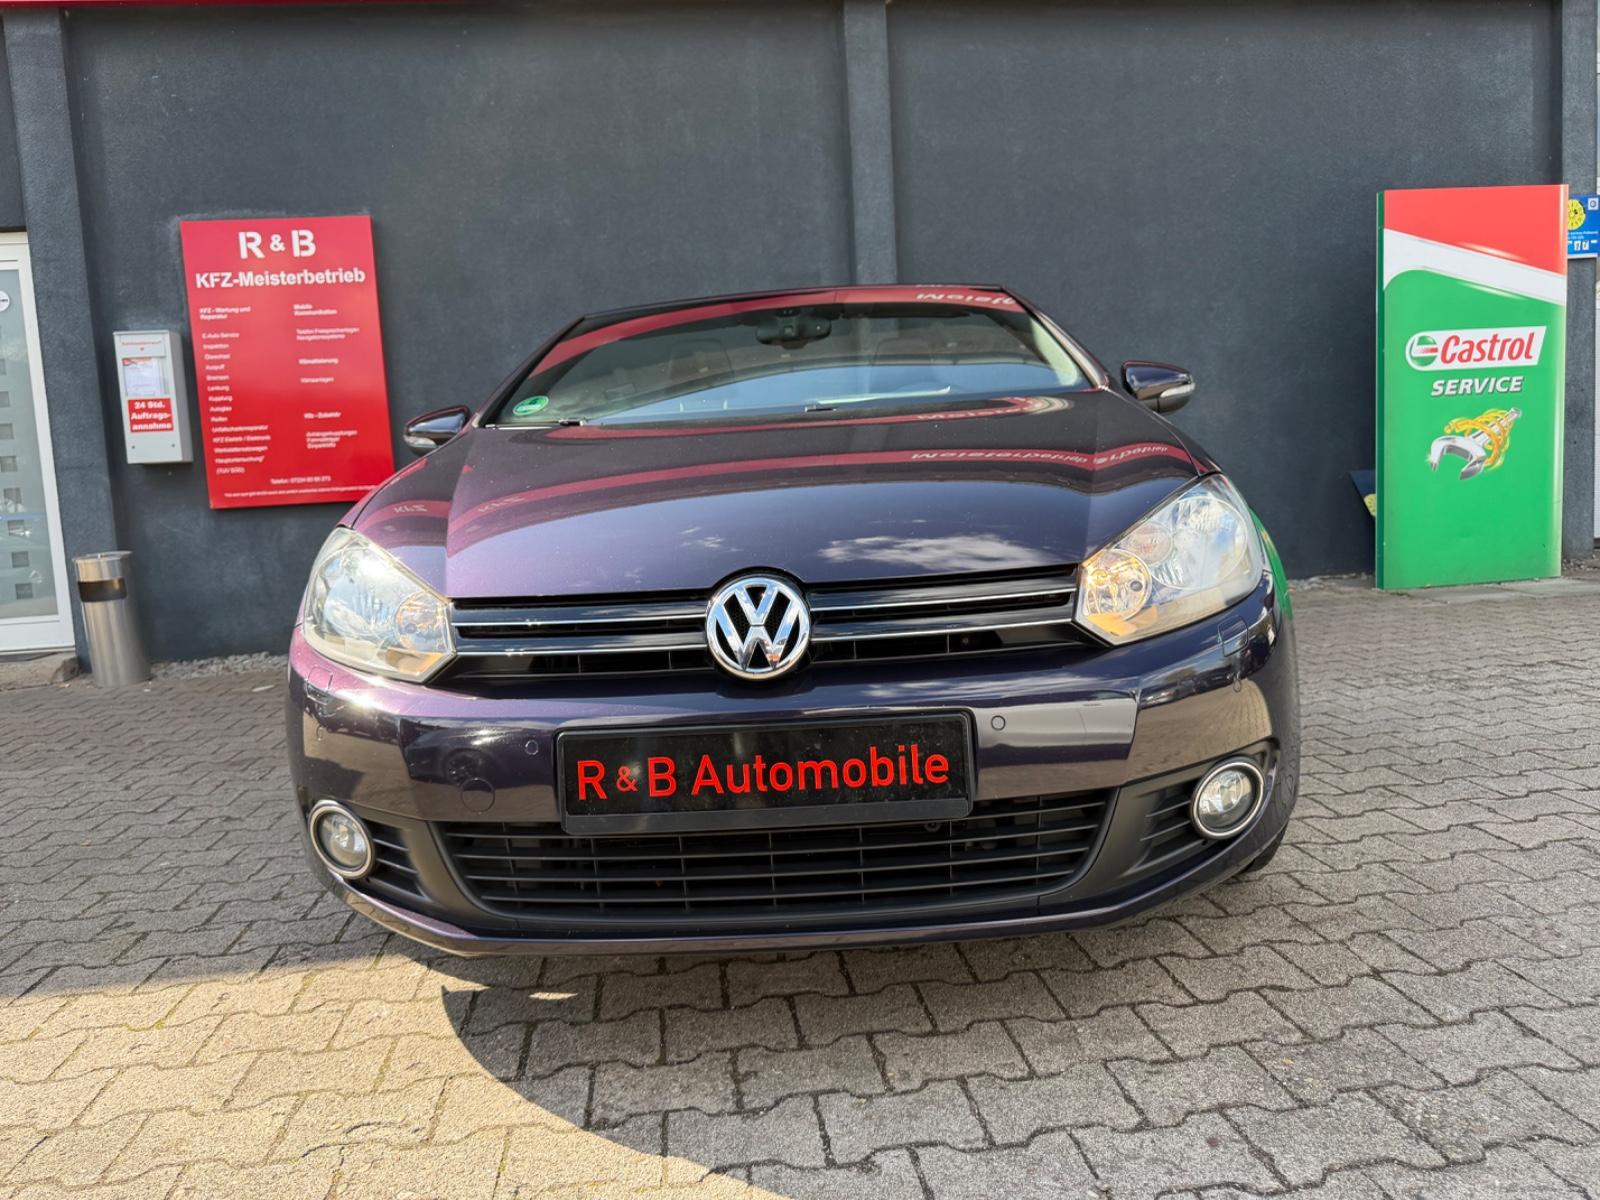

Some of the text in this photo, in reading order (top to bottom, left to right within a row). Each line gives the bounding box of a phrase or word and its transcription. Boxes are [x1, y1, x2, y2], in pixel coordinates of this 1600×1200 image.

[238, 229, 317, 259] R & B
[195, 267, 366, 289] KFZ-Meisterbetrieb
[1440, 331, 1535, 365] Castrol
[1430, 375, 1524, 398] SERVICE
[131, 411, 172, 420] Auftrags-
[134, 400, 165, 409] 24 Std.
[132, 421, 172, 430] annahme
[577, 744, 950, 801] R & B Automobile
